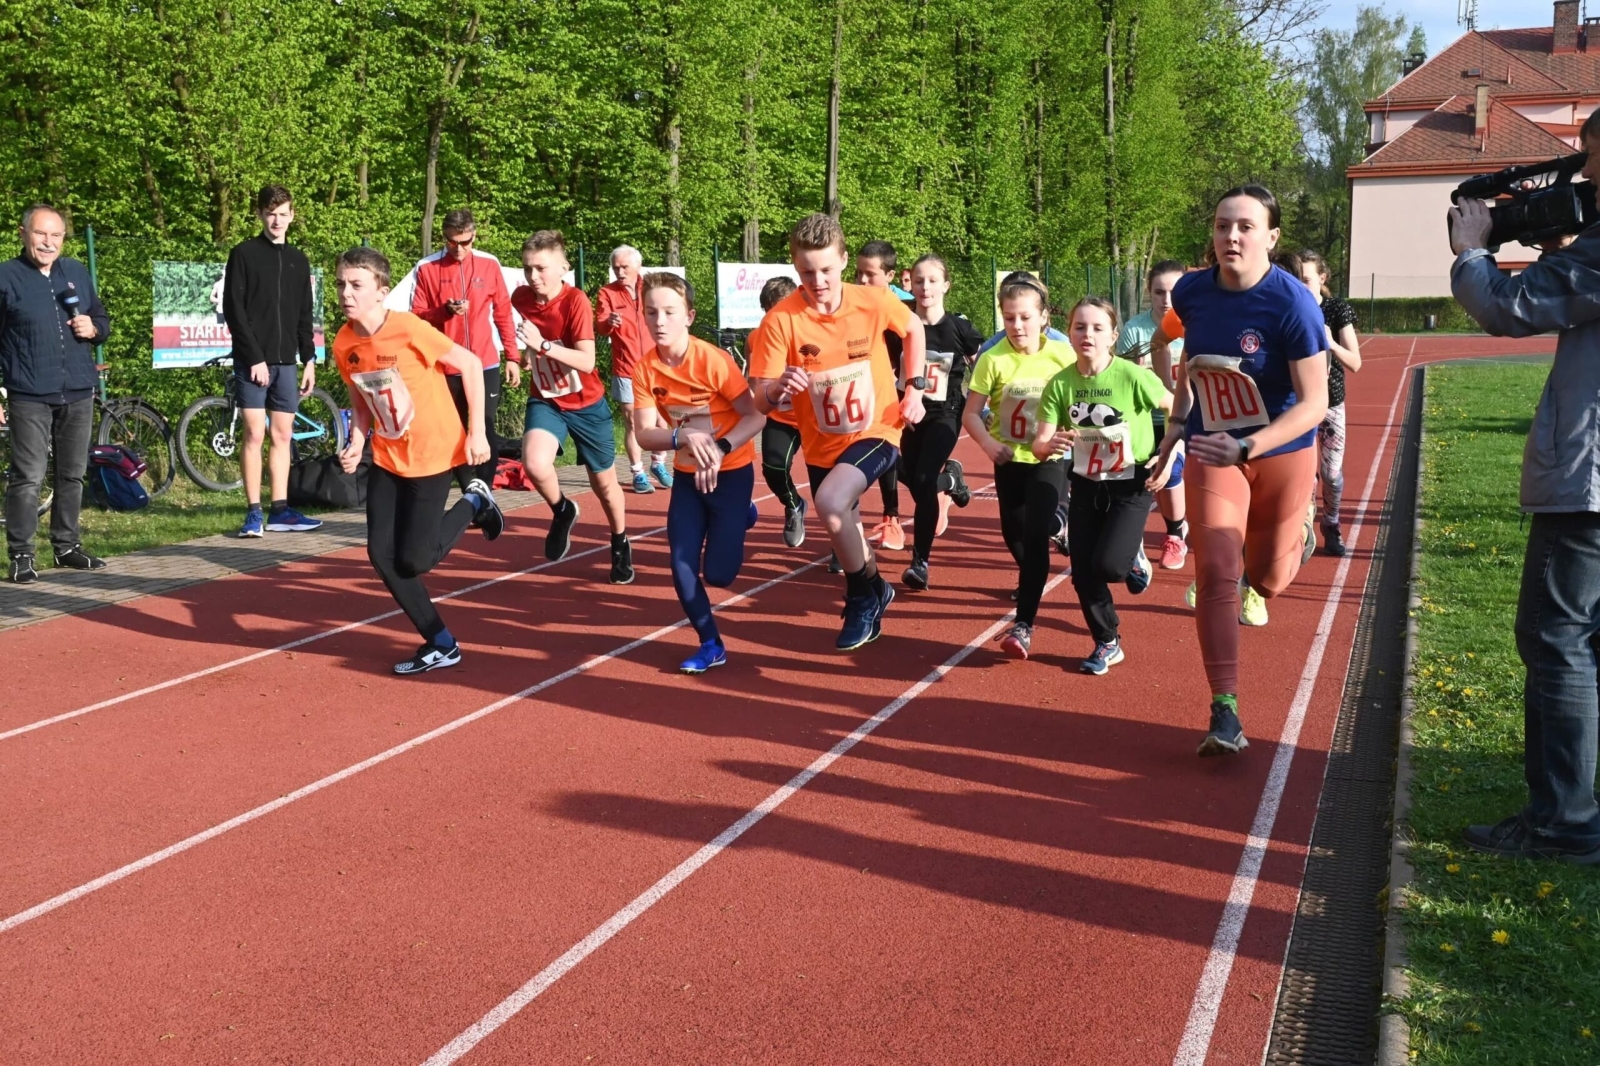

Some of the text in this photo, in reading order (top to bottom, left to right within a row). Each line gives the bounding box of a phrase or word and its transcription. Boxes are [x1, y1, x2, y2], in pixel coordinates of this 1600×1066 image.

[815, 369, 863, 388] PIVOVAR TRUTNOV
[1090, 388, 1113, 398] LENOCH
[1197, 371, 1260, 422] 180
[822, 380, 864, 427] 66
[1086, 440, 1125, 476] 62
